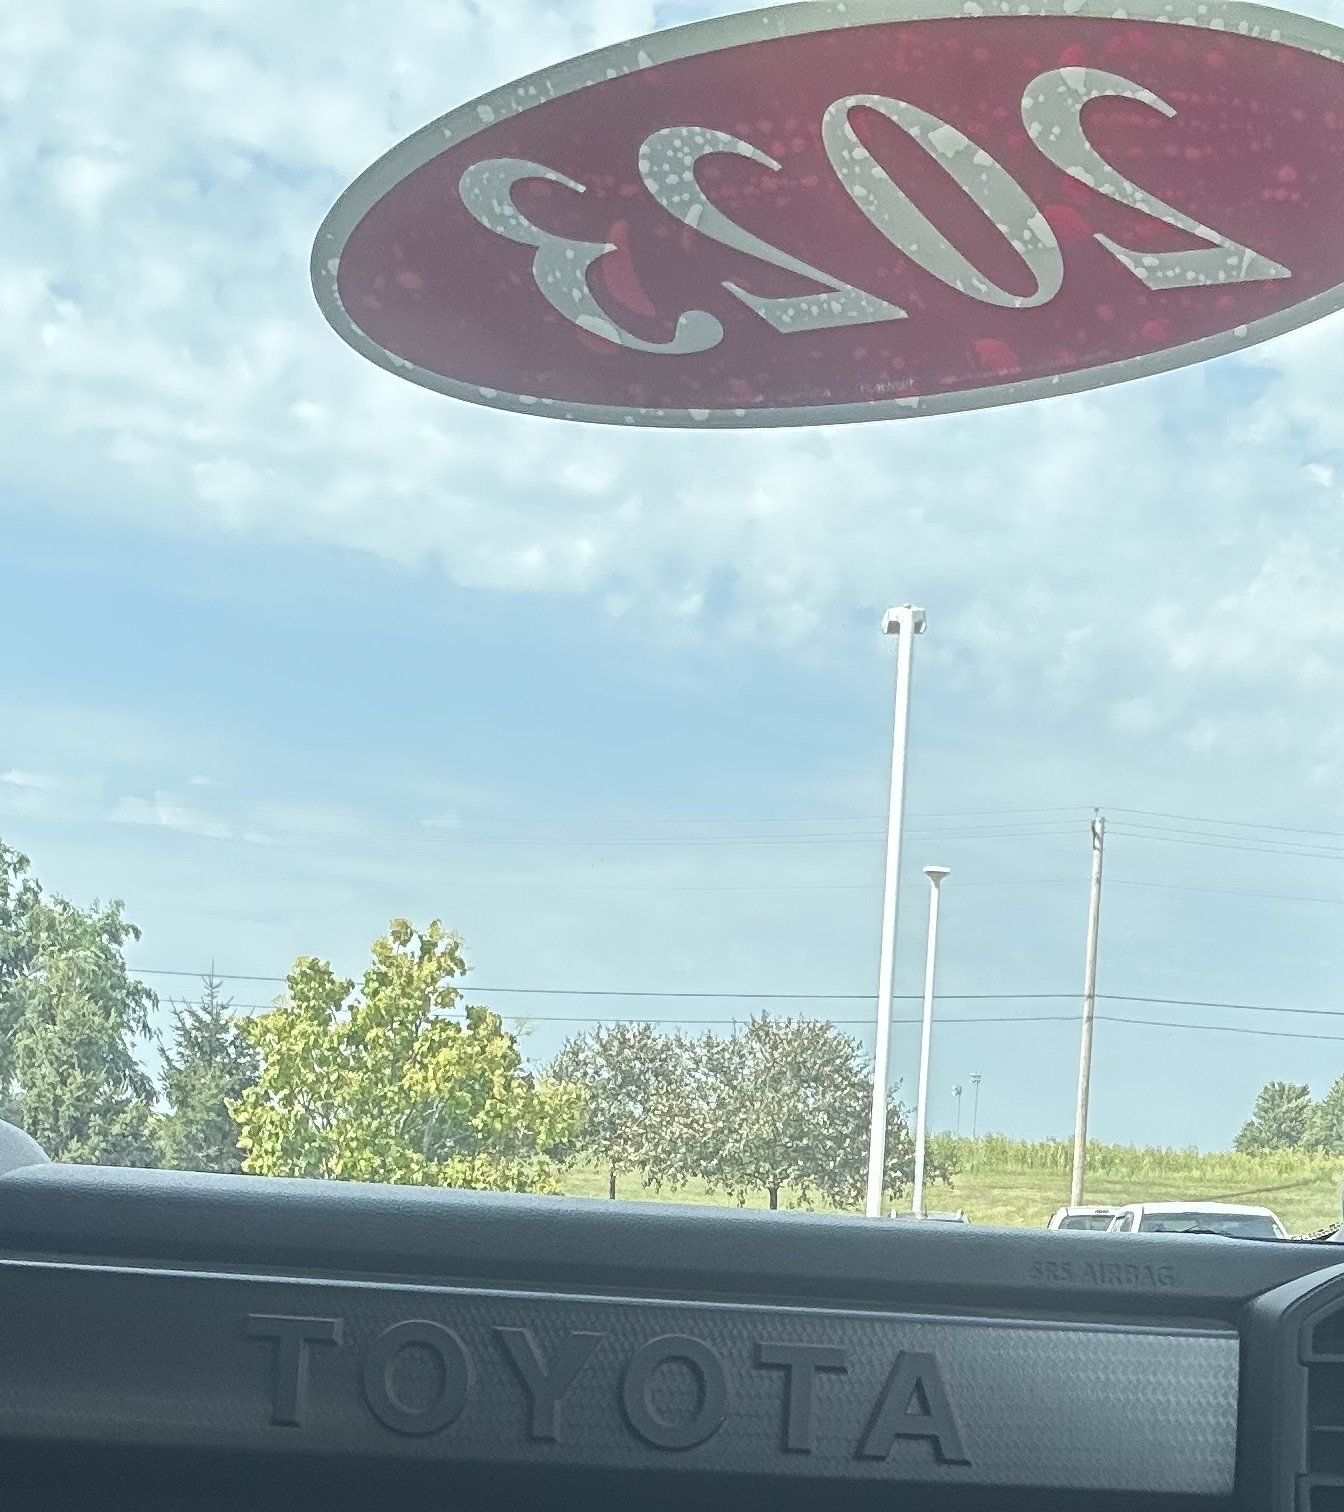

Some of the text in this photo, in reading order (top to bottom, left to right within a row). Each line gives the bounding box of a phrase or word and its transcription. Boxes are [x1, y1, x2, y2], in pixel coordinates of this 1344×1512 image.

[1028, 1260, 1176, 1287] SRS AIRBAG
[244, 1312, 974, 1471] TOYOTA
